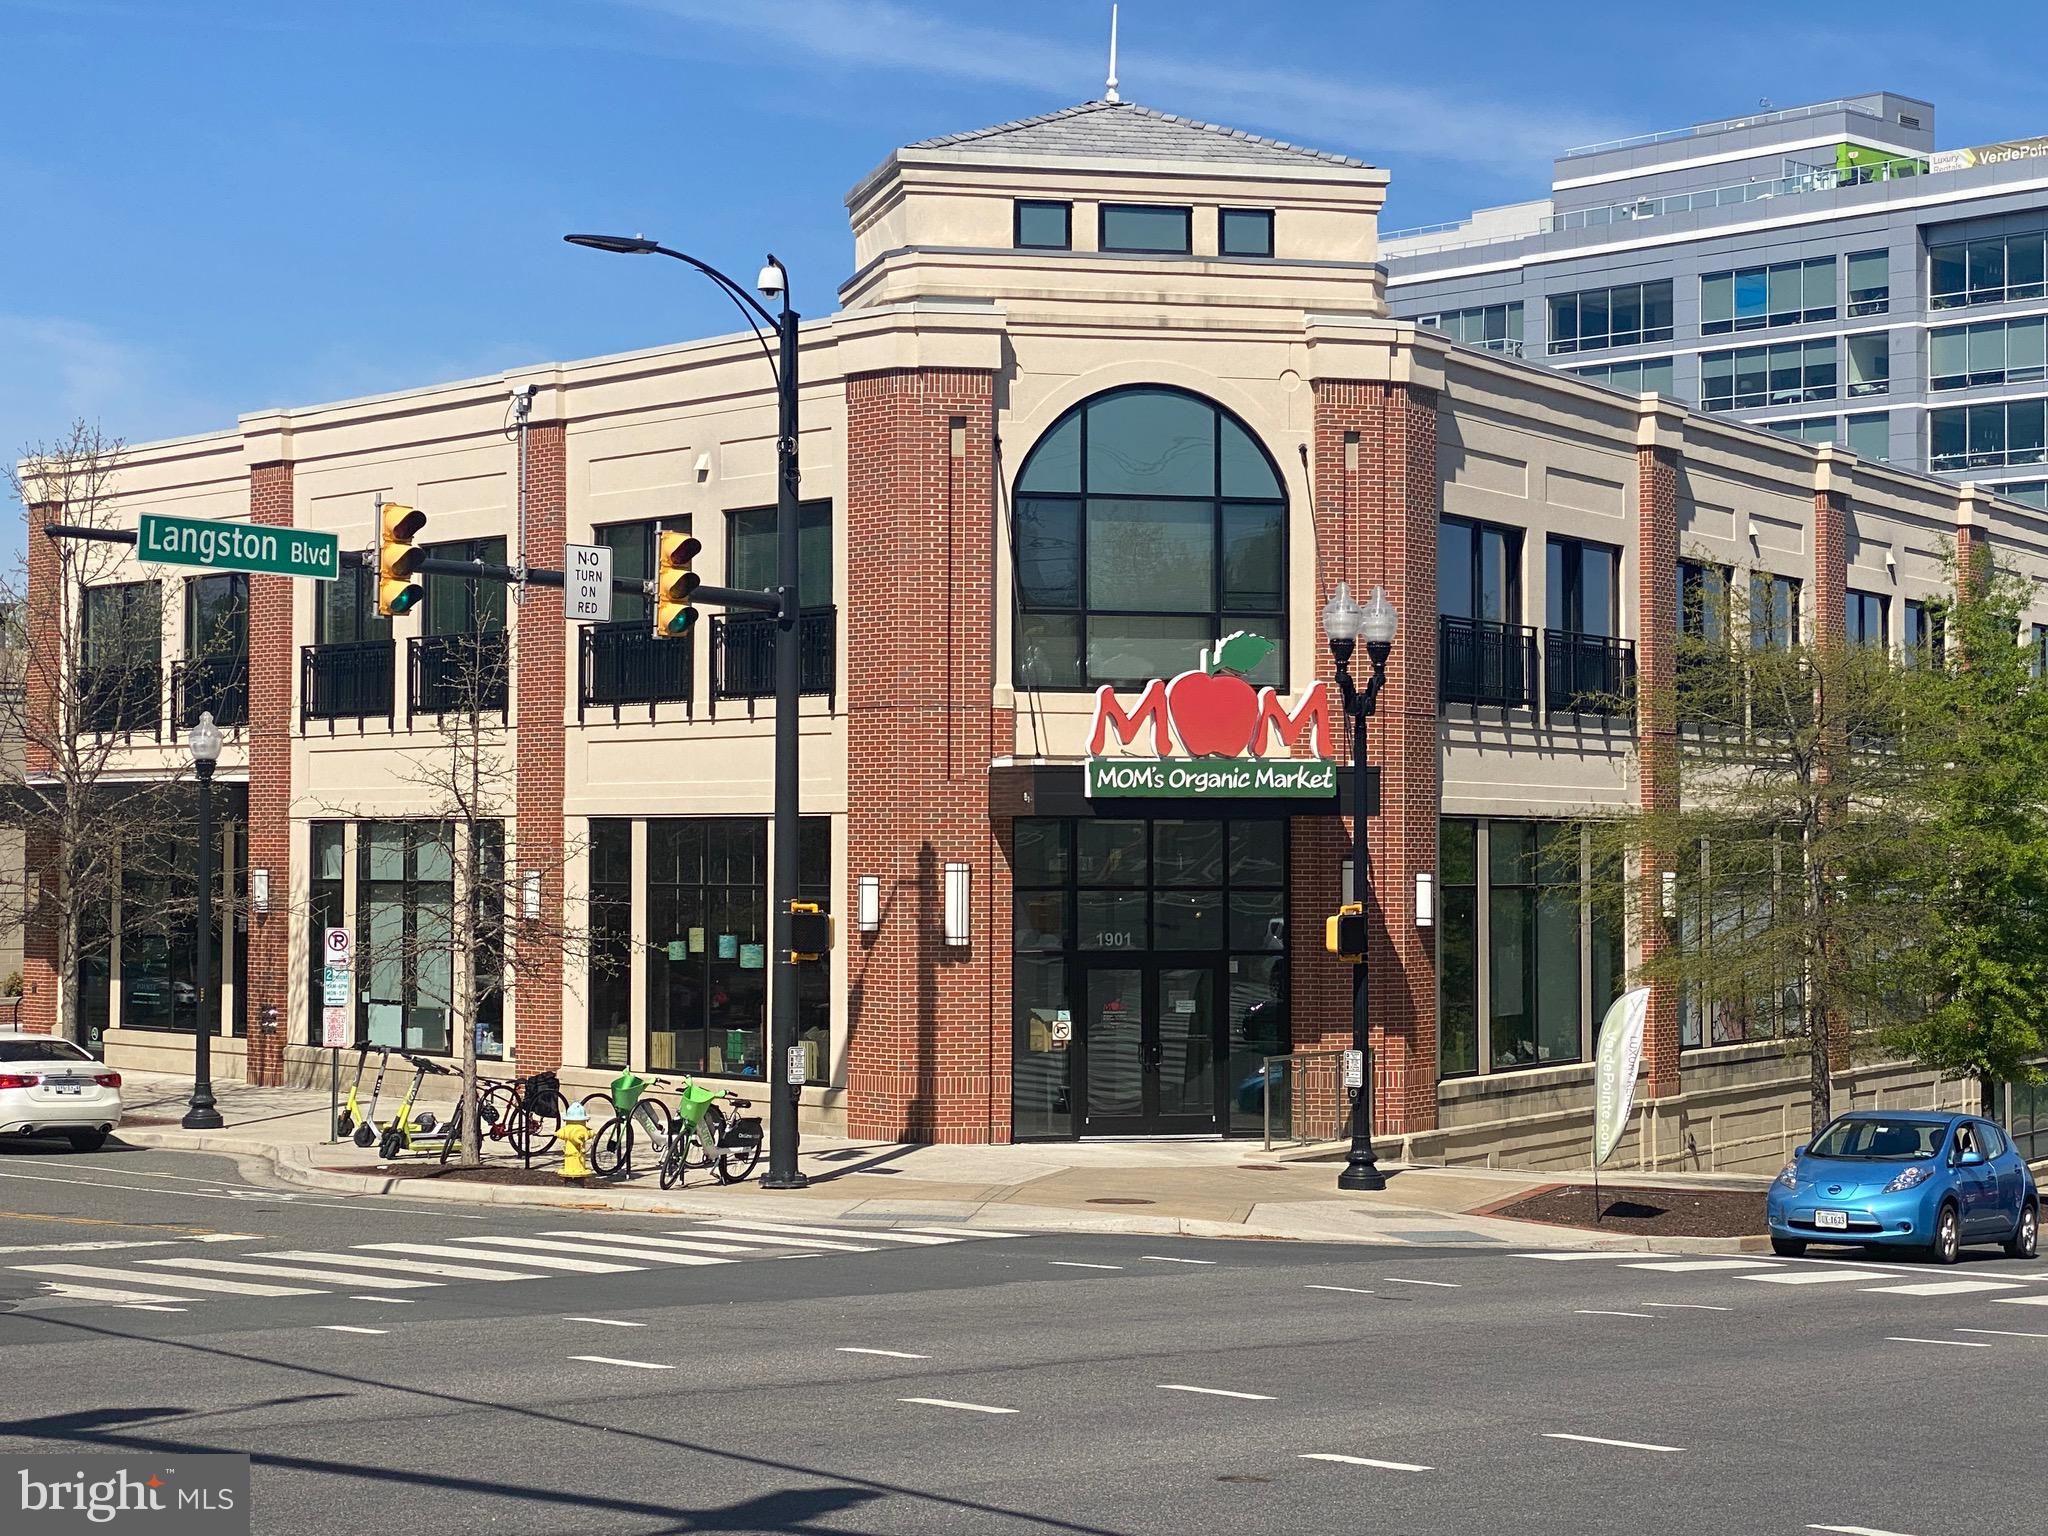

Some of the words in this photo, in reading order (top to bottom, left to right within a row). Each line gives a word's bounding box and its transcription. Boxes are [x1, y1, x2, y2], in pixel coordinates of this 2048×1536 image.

[1933, 154, 1960, 165] Luxury
[148, 519, 277, 564] Langston
[291, 542, 330, 566] Blvd
[578, 551, 599, 566] NO
[575, 569, 603, 582] TURN
[581, 585, 596, 598] ON
[577, 602, 598, 614] RED
[1096, 766, 1165, 790] MOM's
[1168, 767, 1251, 792] Organic
[1254, 765, 1334, 790] Market
[1096, 932, 1130, 946] 1901
